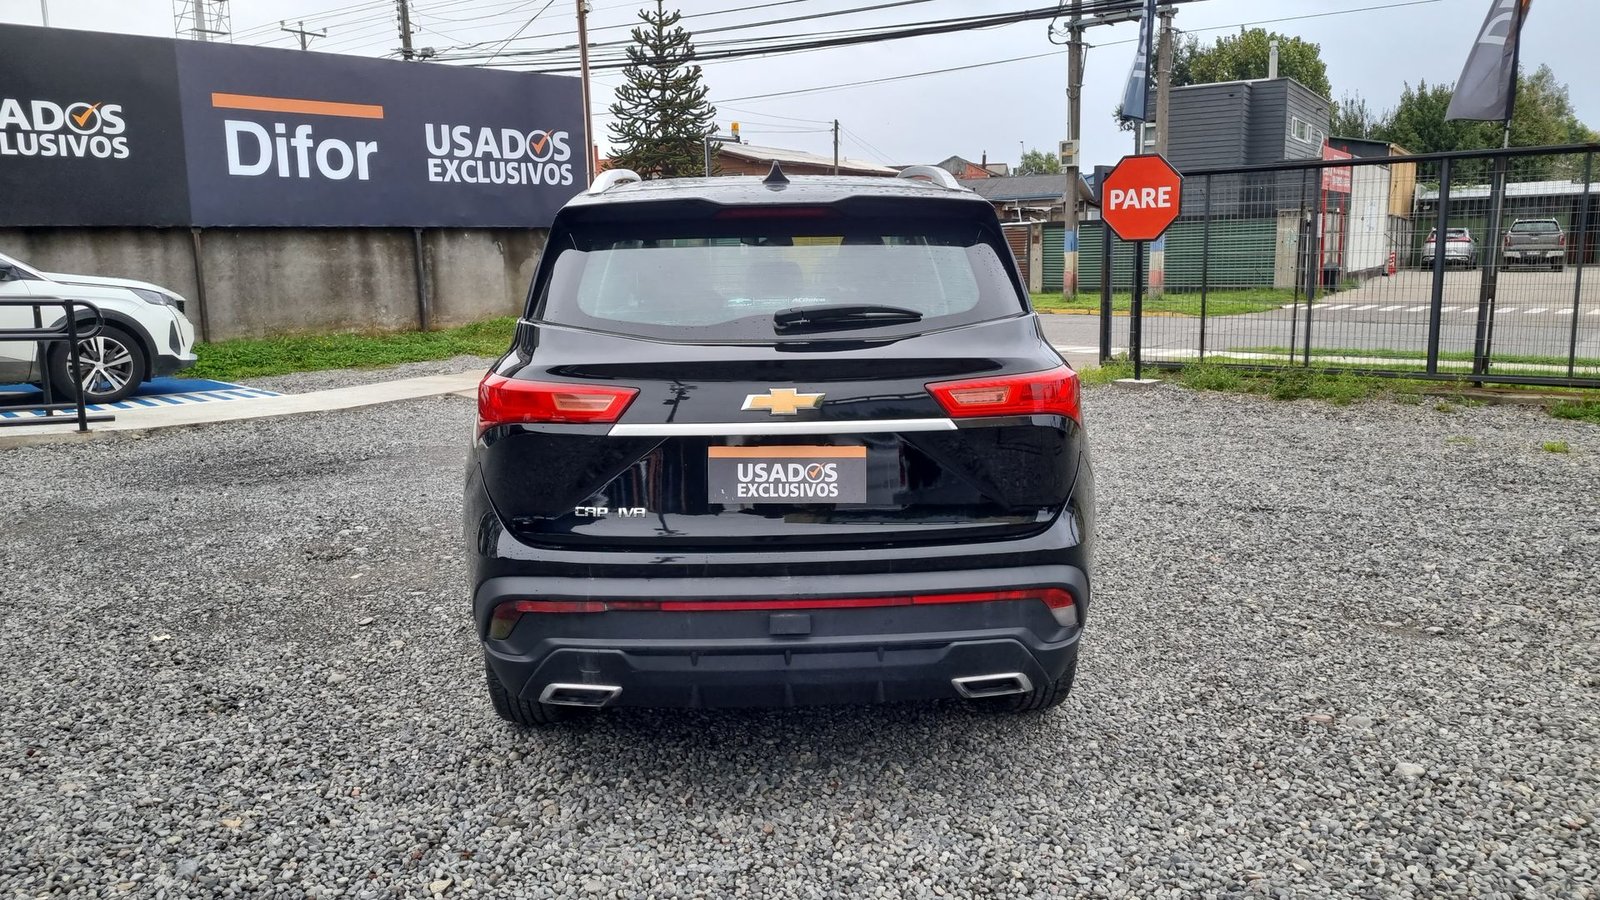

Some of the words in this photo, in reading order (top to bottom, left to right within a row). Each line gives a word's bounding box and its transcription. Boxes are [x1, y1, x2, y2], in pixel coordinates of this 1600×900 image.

[224, 119, 378, 181] Difor
[425, 123, 571, 162] USADOS
[427, 157, 574, 186] EXCLUSIVOS
[1109, 186, 1172, 210] PARE
[737, 462, 838, 483] USADOS
[737, 483, 839, 498] EXCLUSIVOS
